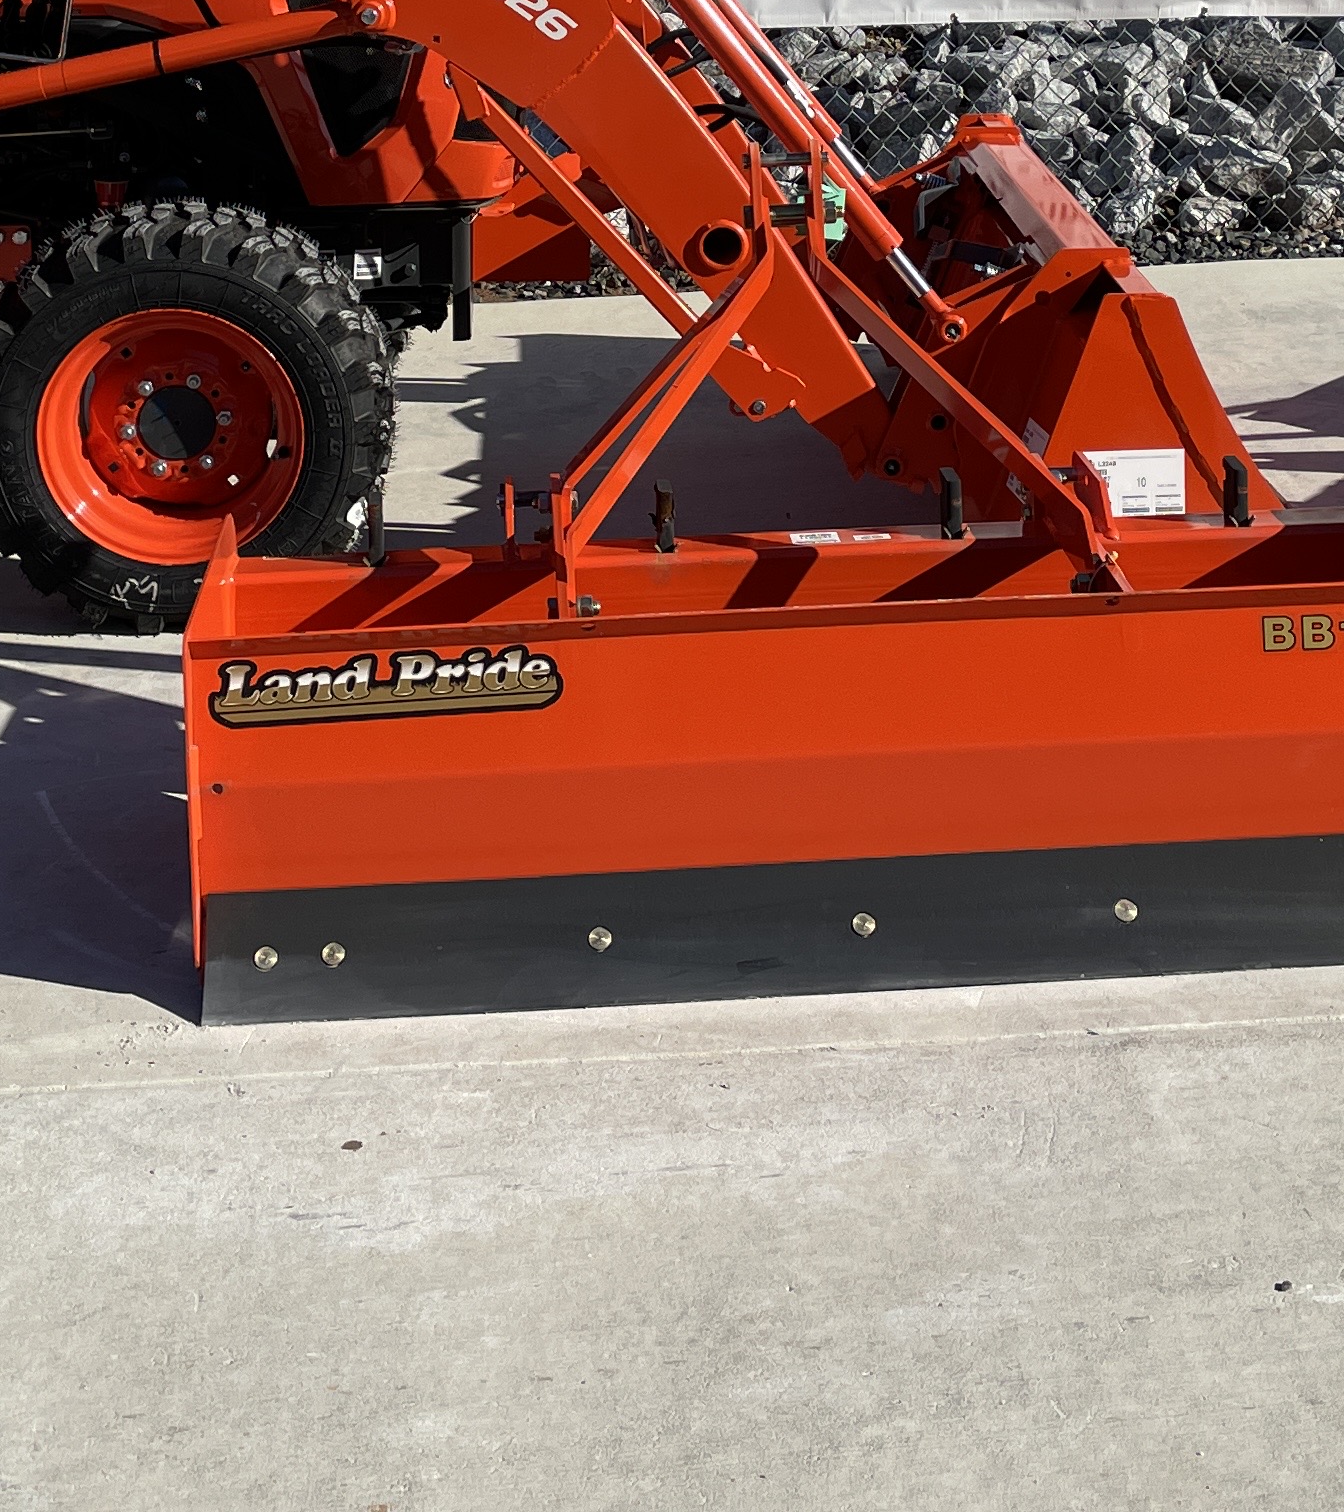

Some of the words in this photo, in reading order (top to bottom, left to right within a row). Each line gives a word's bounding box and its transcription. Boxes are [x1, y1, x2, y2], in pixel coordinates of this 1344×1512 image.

[1136, 477, 1147, 488] 10
[218, 655, 375, 709] Land
[393, 645, 553, 699] Pride
